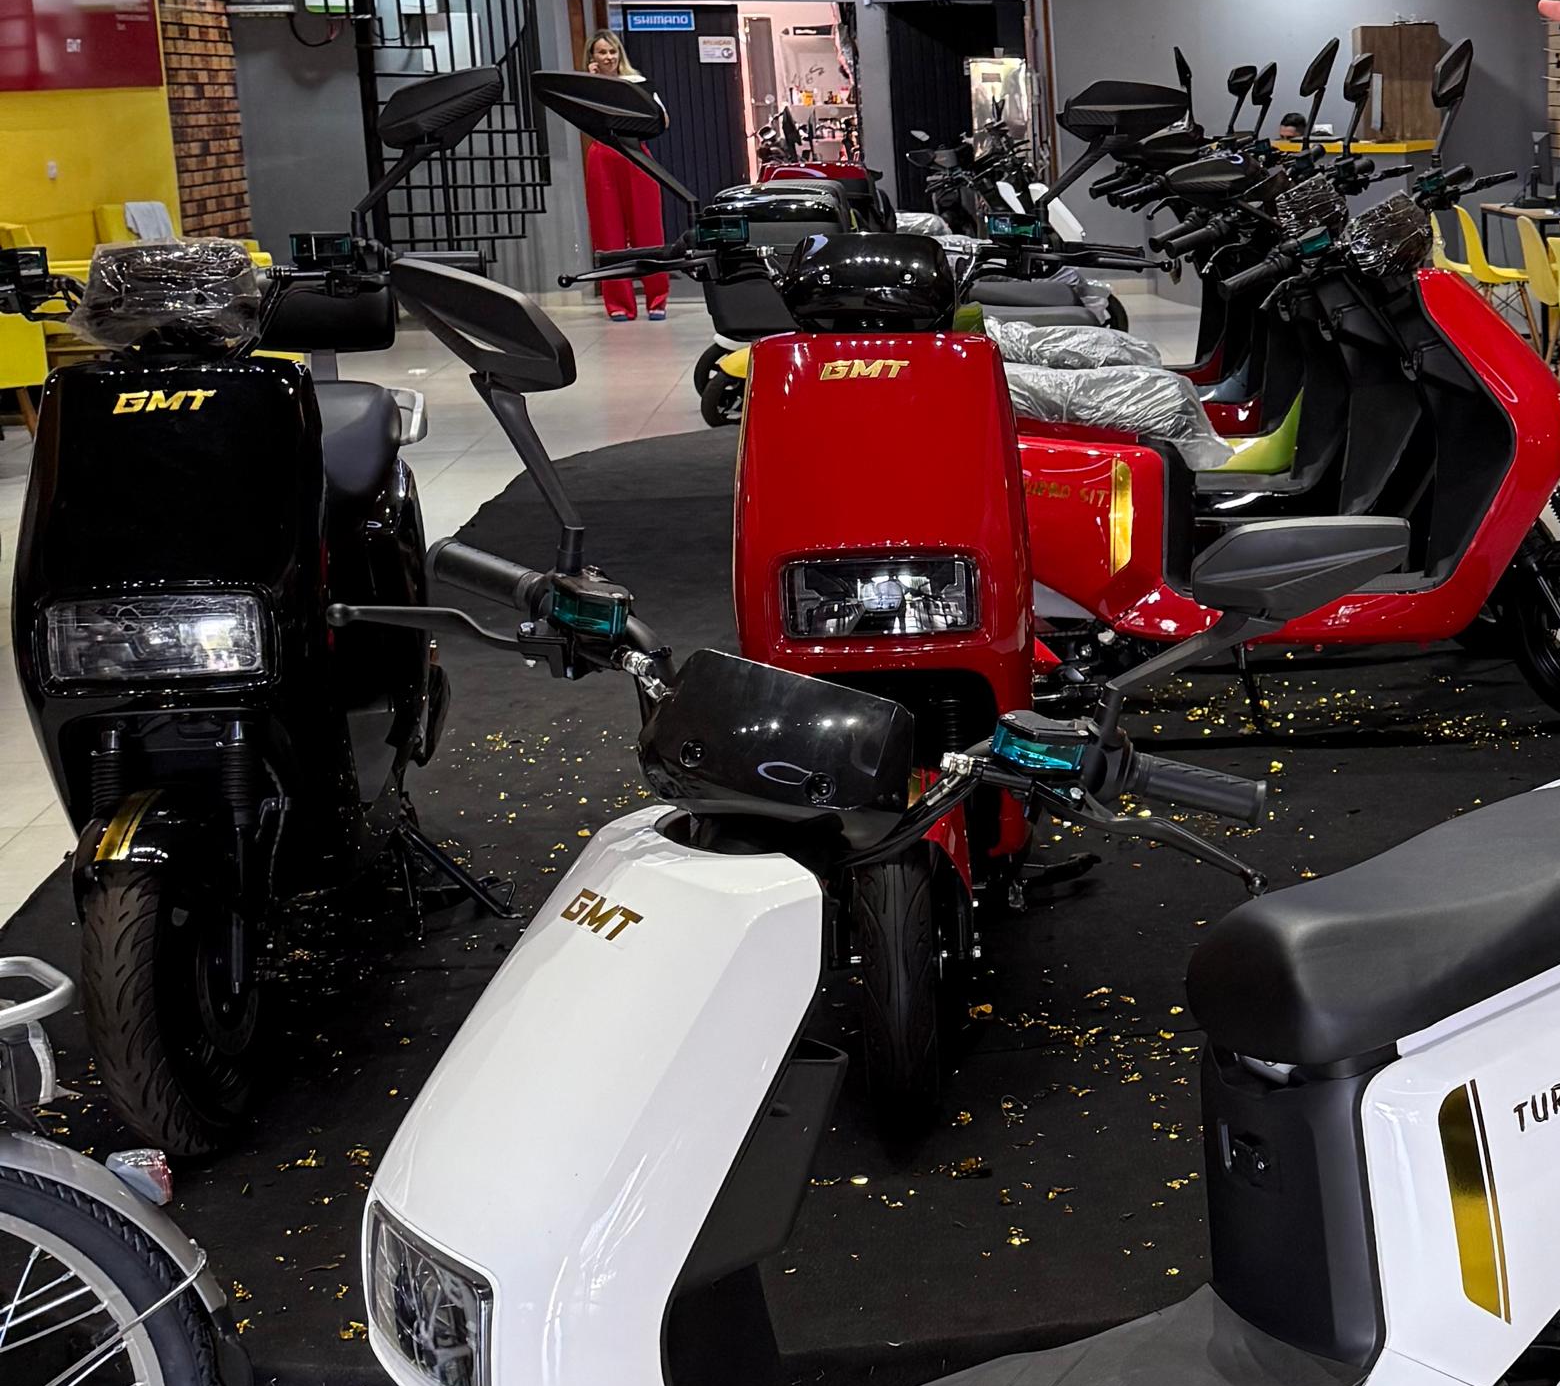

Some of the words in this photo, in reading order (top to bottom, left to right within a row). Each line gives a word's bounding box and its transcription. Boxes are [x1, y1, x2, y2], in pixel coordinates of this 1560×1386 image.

[633, 15, 689, 25] SHIMANO
[819, 359, 910, 381] GMT
[112, 389, 217, 415] GMT
[560, 887, 644, 941] GMT
